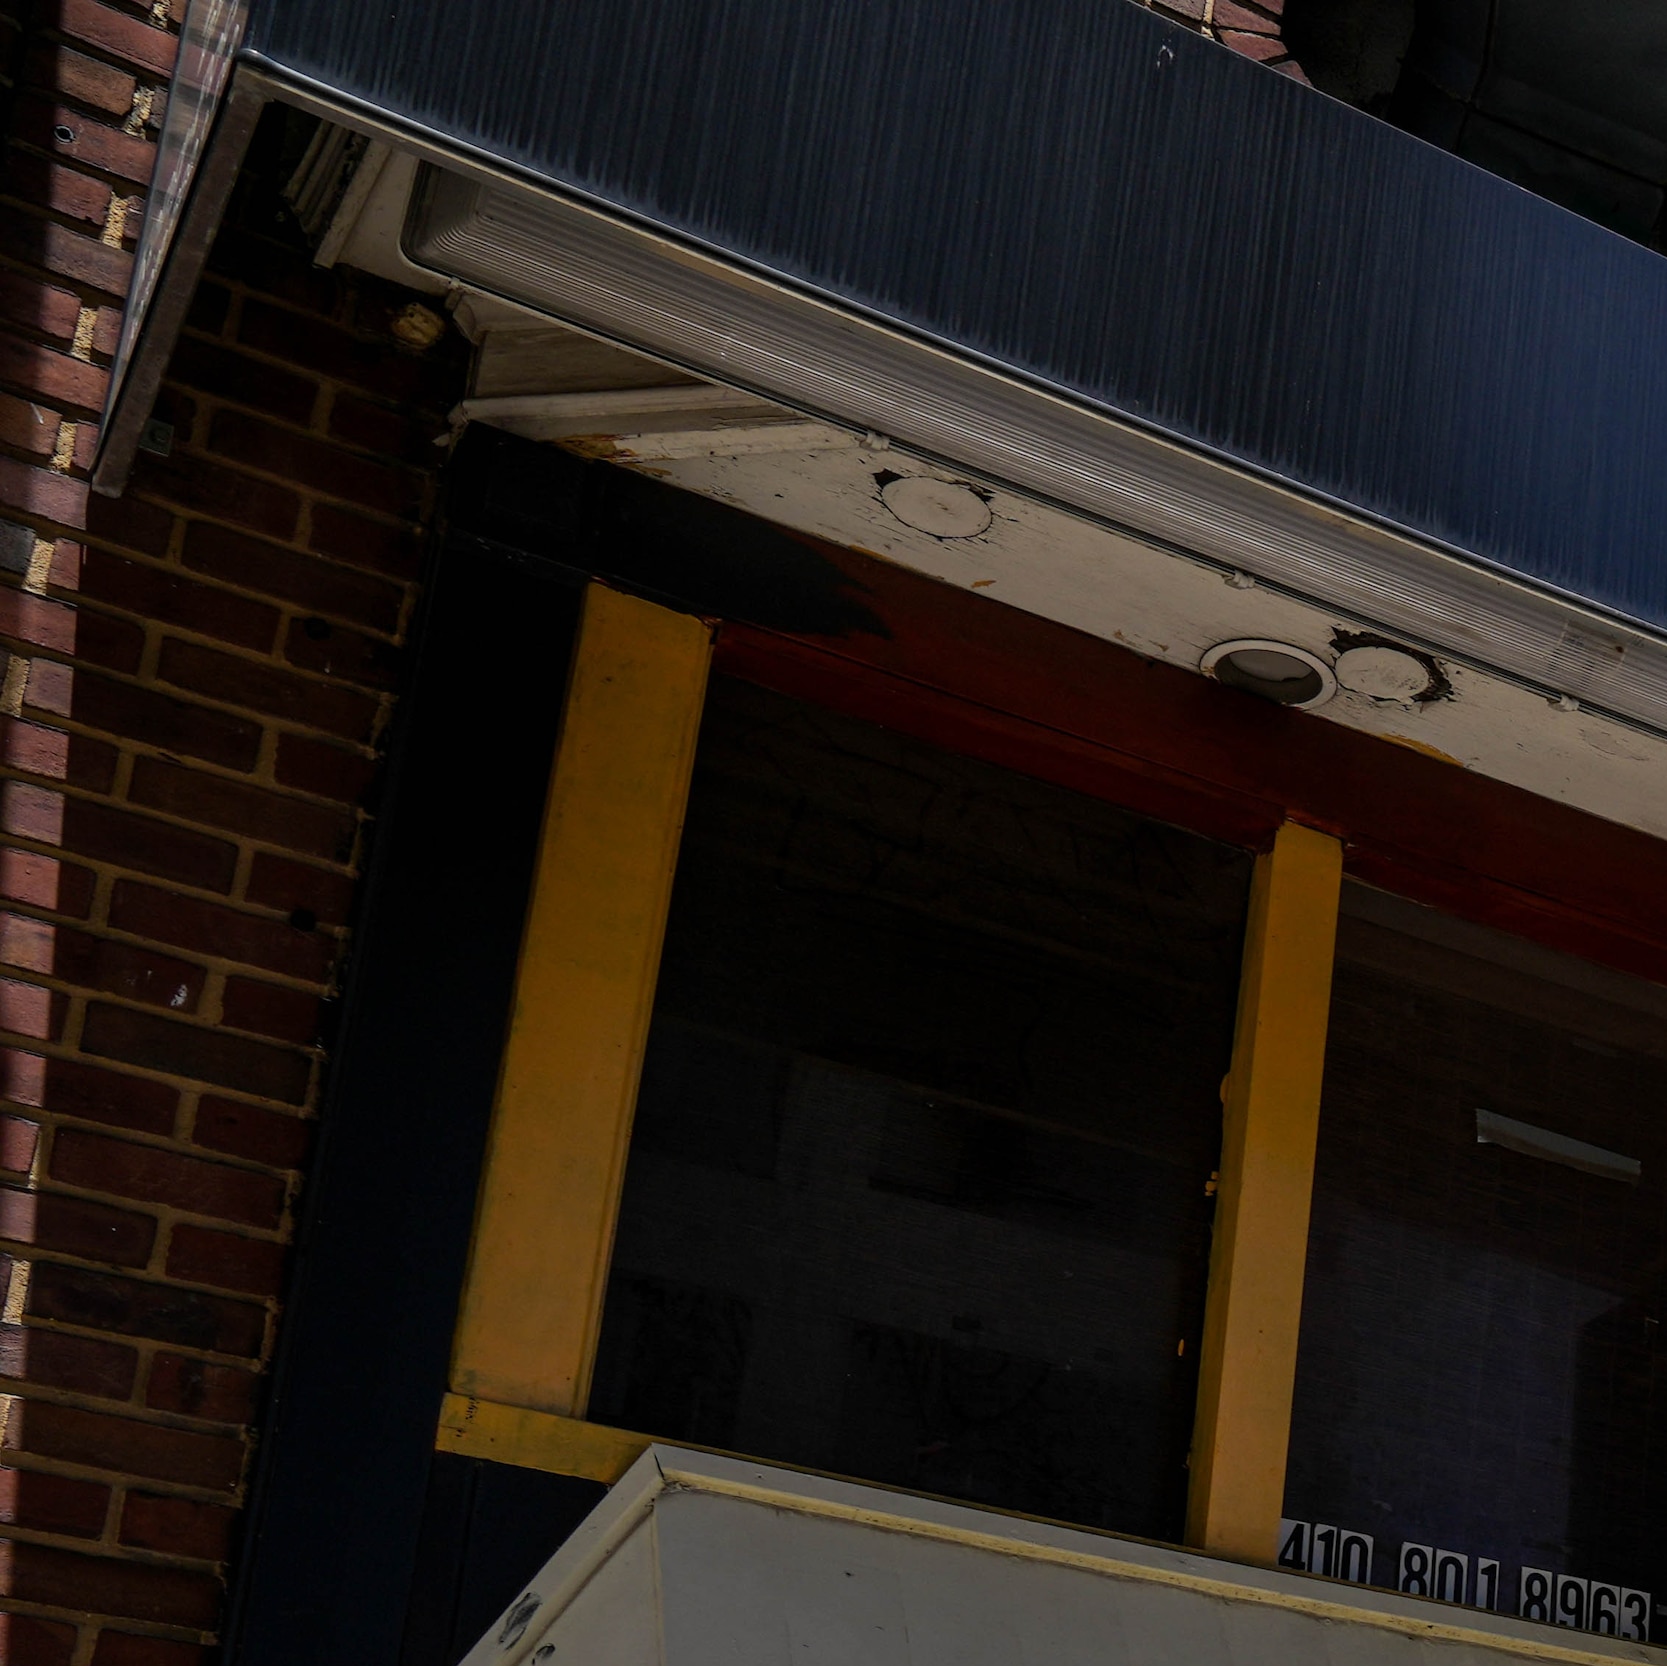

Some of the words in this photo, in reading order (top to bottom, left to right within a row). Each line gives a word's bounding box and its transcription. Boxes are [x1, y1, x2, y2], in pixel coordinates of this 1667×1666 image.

[1279, 1522, 1370, 1584] 410
[1402, 1546, 1498, 1612] 801
[1523, 1571, 1649, 1642] 8963
